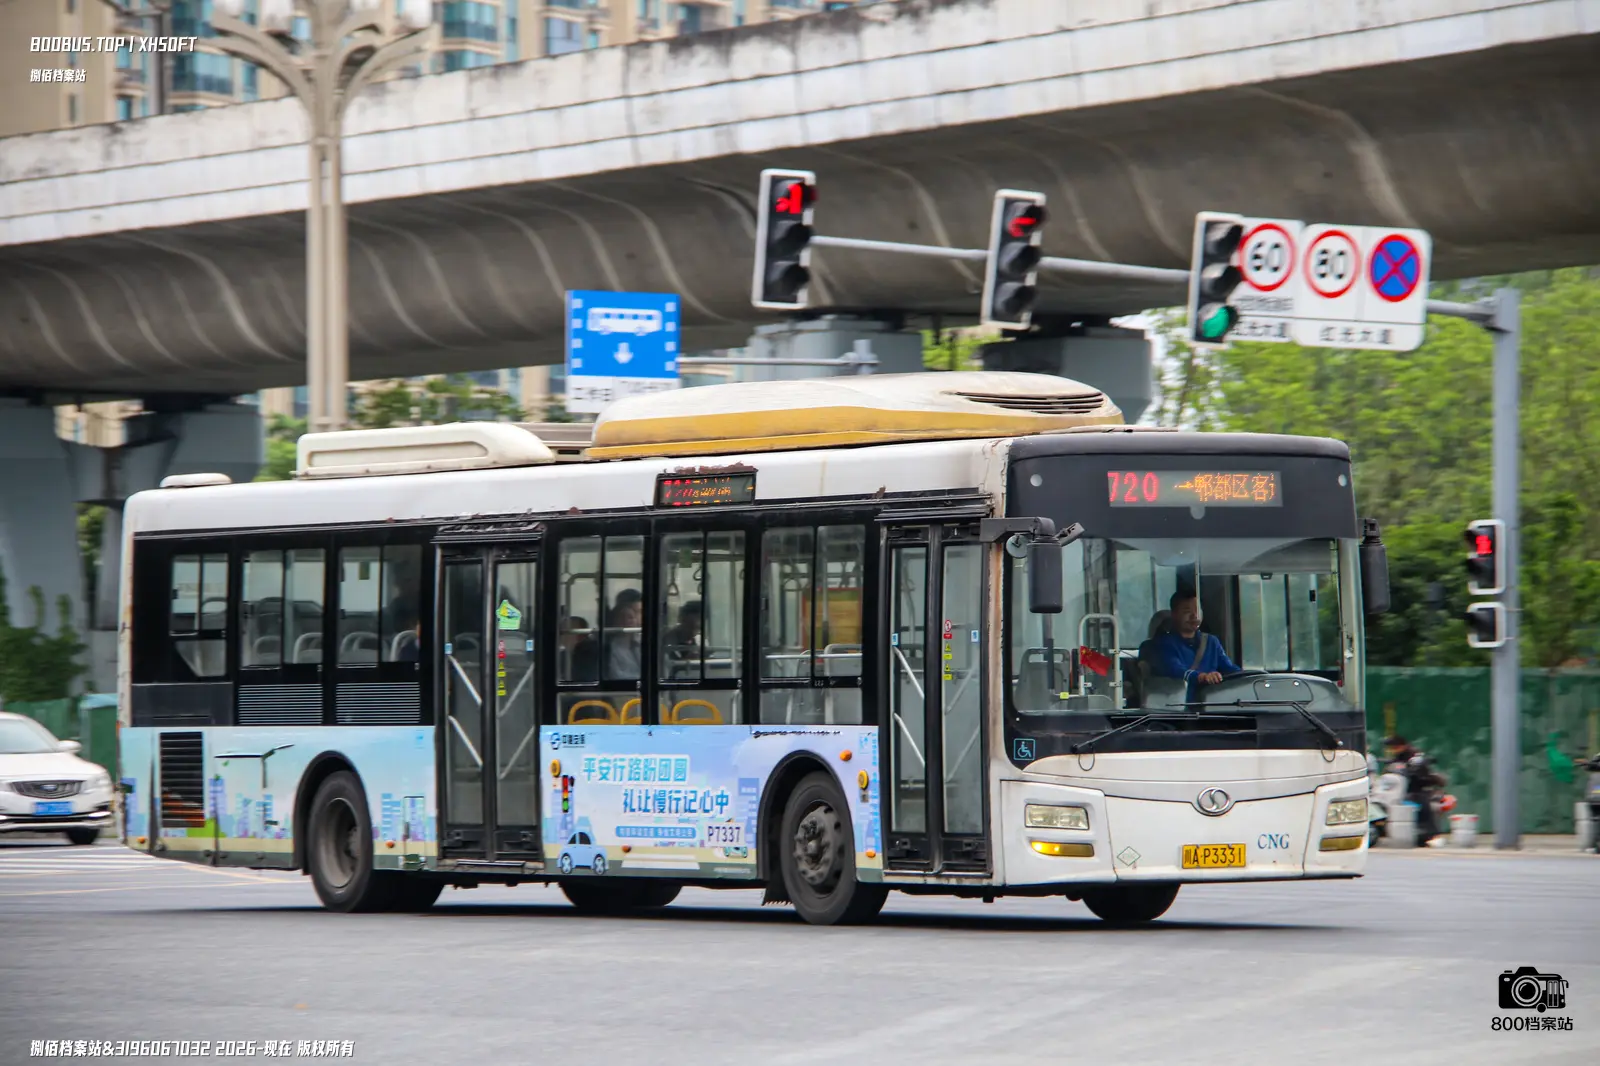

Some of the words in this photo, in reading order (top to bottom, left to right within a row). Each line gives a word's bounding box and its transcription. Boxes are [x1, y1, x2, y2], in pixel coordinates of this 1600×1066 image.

[1250, 241, 1284, 272] 60
[1315, 249, 1346, 279] 80
[1107, 471, 1159, 502] 720
[583, 756, 688, 782] 平安行路盼团圆
[623, 787, 730, 815] 礼让慢行记心中
[707, 826, 741, 843] P7337
[1257, 833, 1290, 850] CNG
